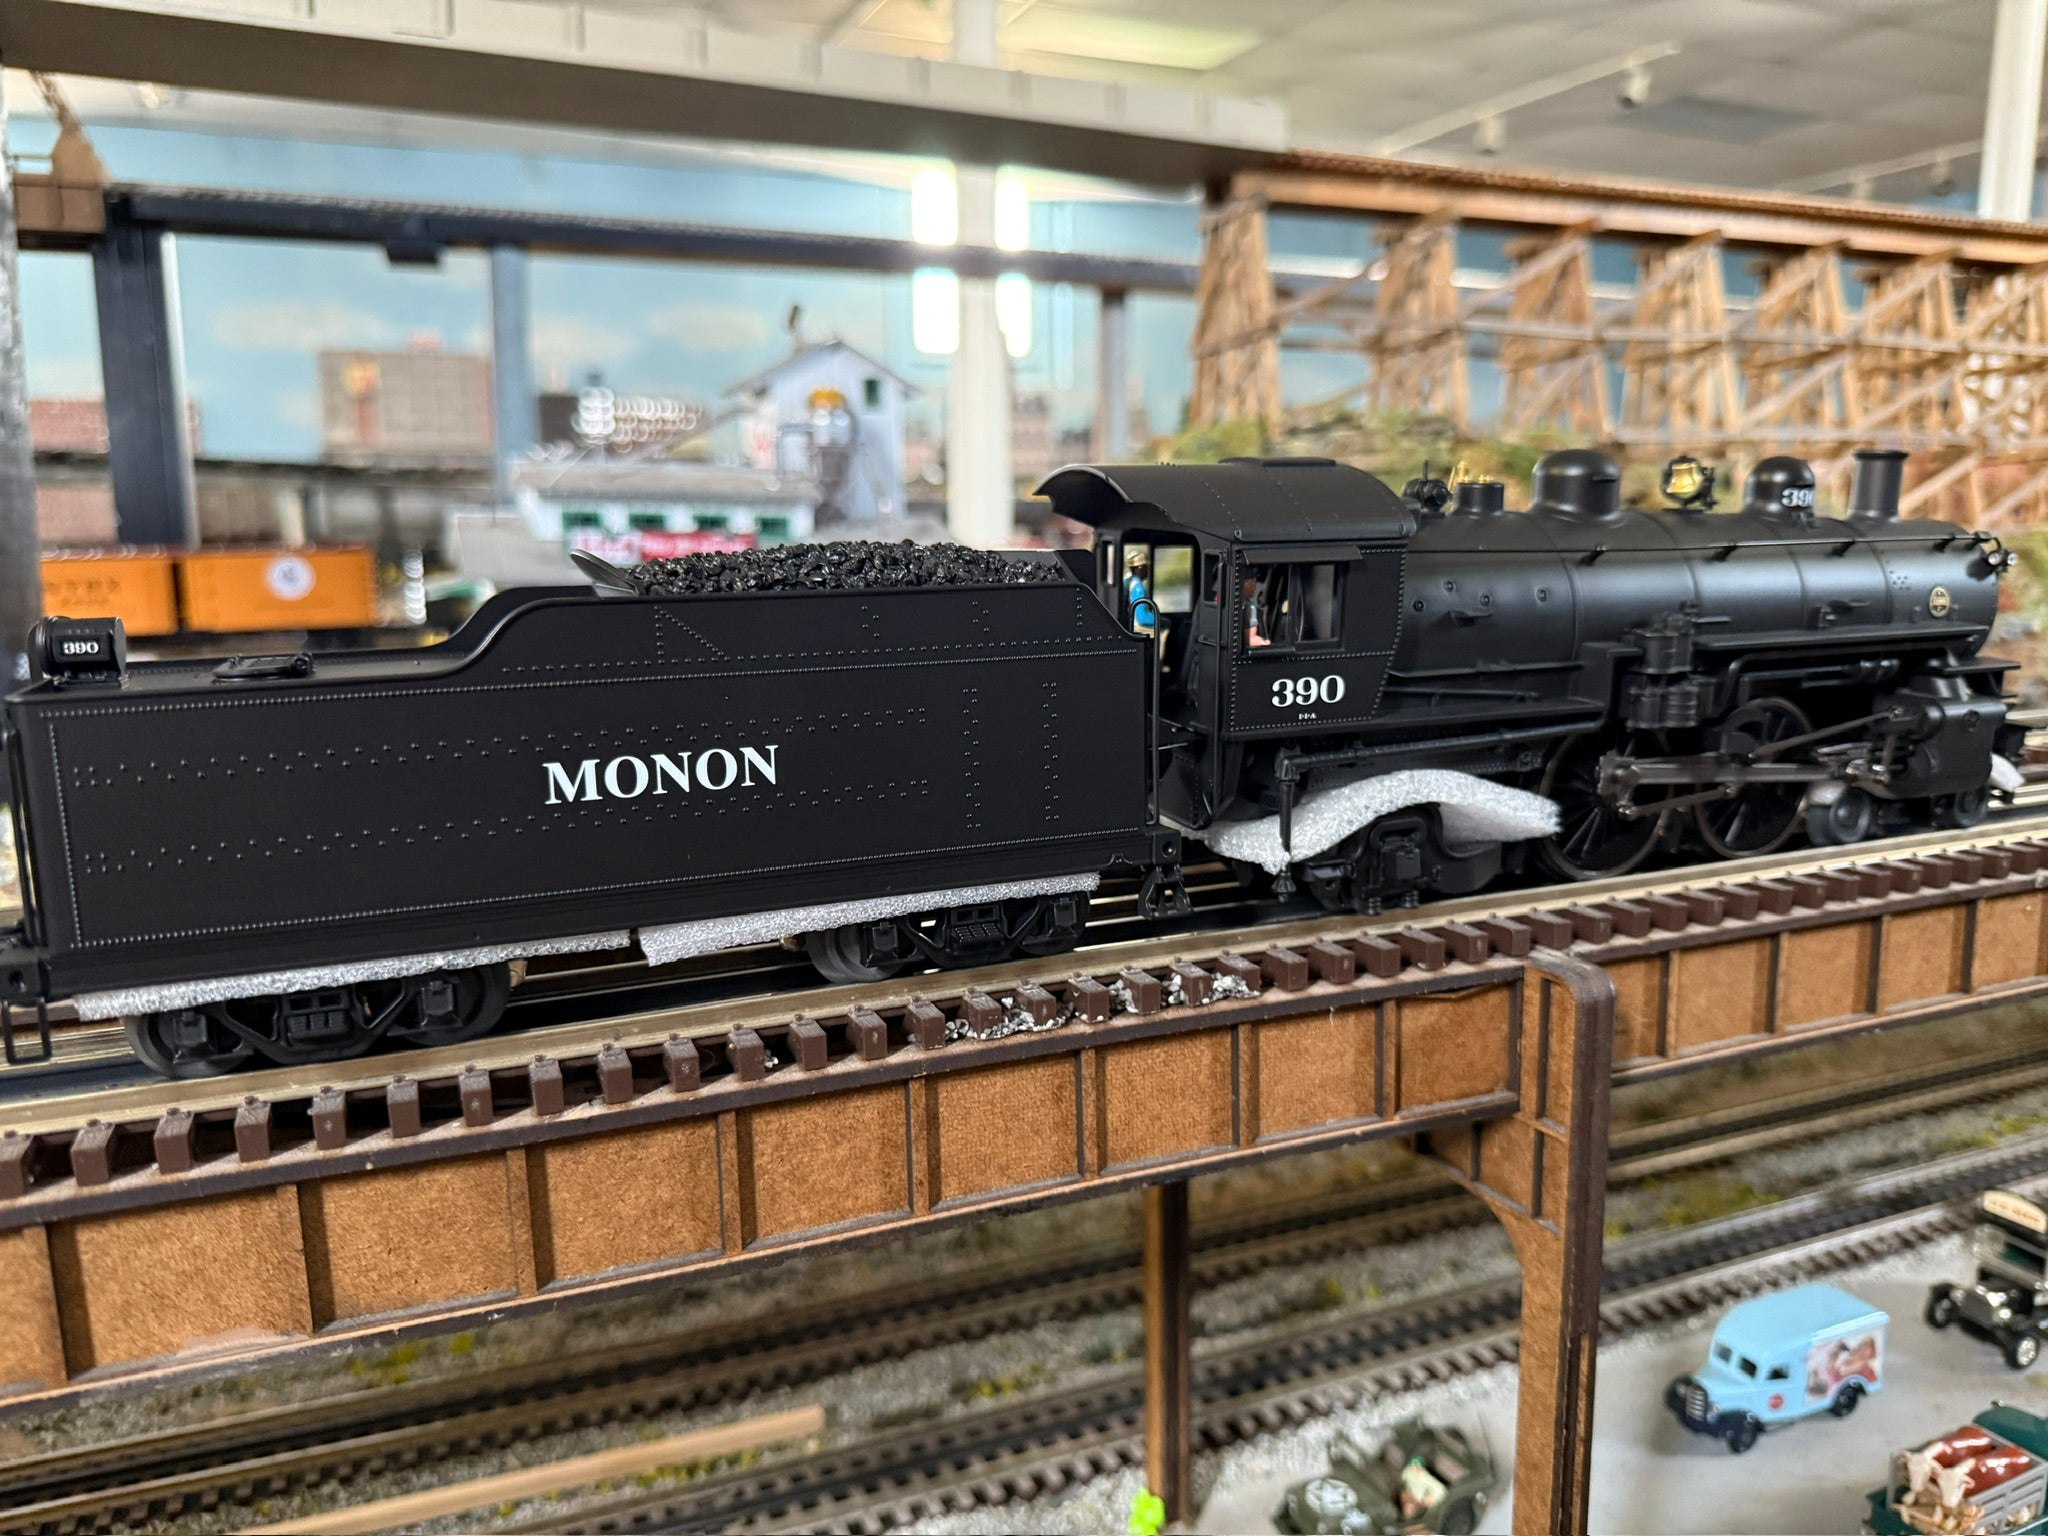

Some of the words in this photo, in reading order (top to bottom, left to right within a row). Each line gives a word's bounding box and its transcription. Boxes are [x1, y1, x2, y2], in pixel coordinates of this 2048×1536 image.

[63, 641, 99, 654] 390
[1271, 674, 1346, 708] 390
[542, 744, 779, 805] MONON
